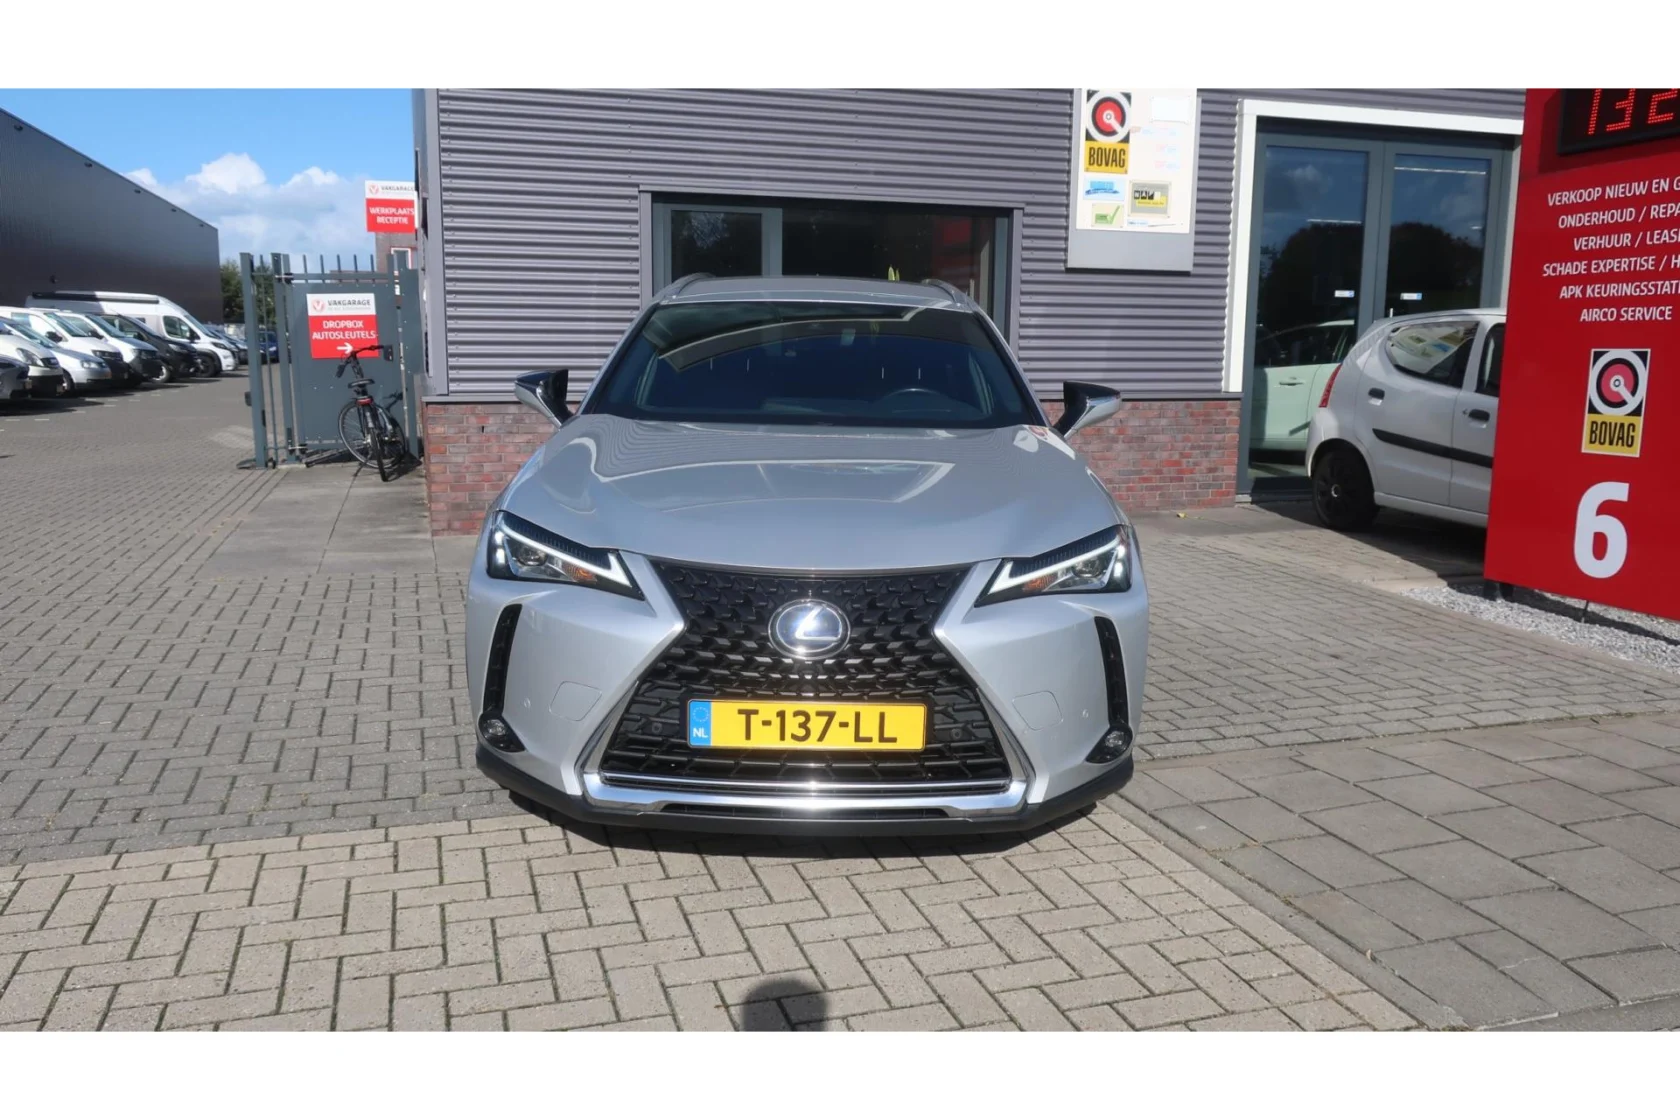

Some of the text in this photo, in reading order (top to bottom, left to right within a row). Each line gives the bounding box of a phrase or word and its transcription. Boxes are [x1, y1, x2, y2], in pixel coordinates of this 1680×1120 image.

[1088, 147, 1126, 168] BOVAG
[1547, 187, 1602, 207] VERKOOP
[1605, 181, 1649, 200] NIEUW
[1652, 178, 1670, 193] EN
[369, 207, 414, 215] WERKPLAATS
[376, 216, 409, 225] RECEPTIE
[1558, 203, 1680, 229] ONDERHOUD / REPA
[1573, 233, 1632, 251] VERHUUR
[1634, 231, 1643, 248] /
[1542, 260, 1588, 277] SCHADE
[1590, 256, 1656, 274] EXPERTISE
[1658, 255, 1668, 272] /
[1559, 285, 1583, 299] APK
[1579, 306, 1673, 322] AIRCO SERVICE
[322, 320, 364, 329] DROPBOX
[312, 331, 377, 340] AUTOSLEUTELS
[1589, 420, 1636, 448] BOVAG
[1574, 481, 1630, 579] 6
[692, 727, 708, 739] NL
[737, 709, 898, 744] T-137-LL
